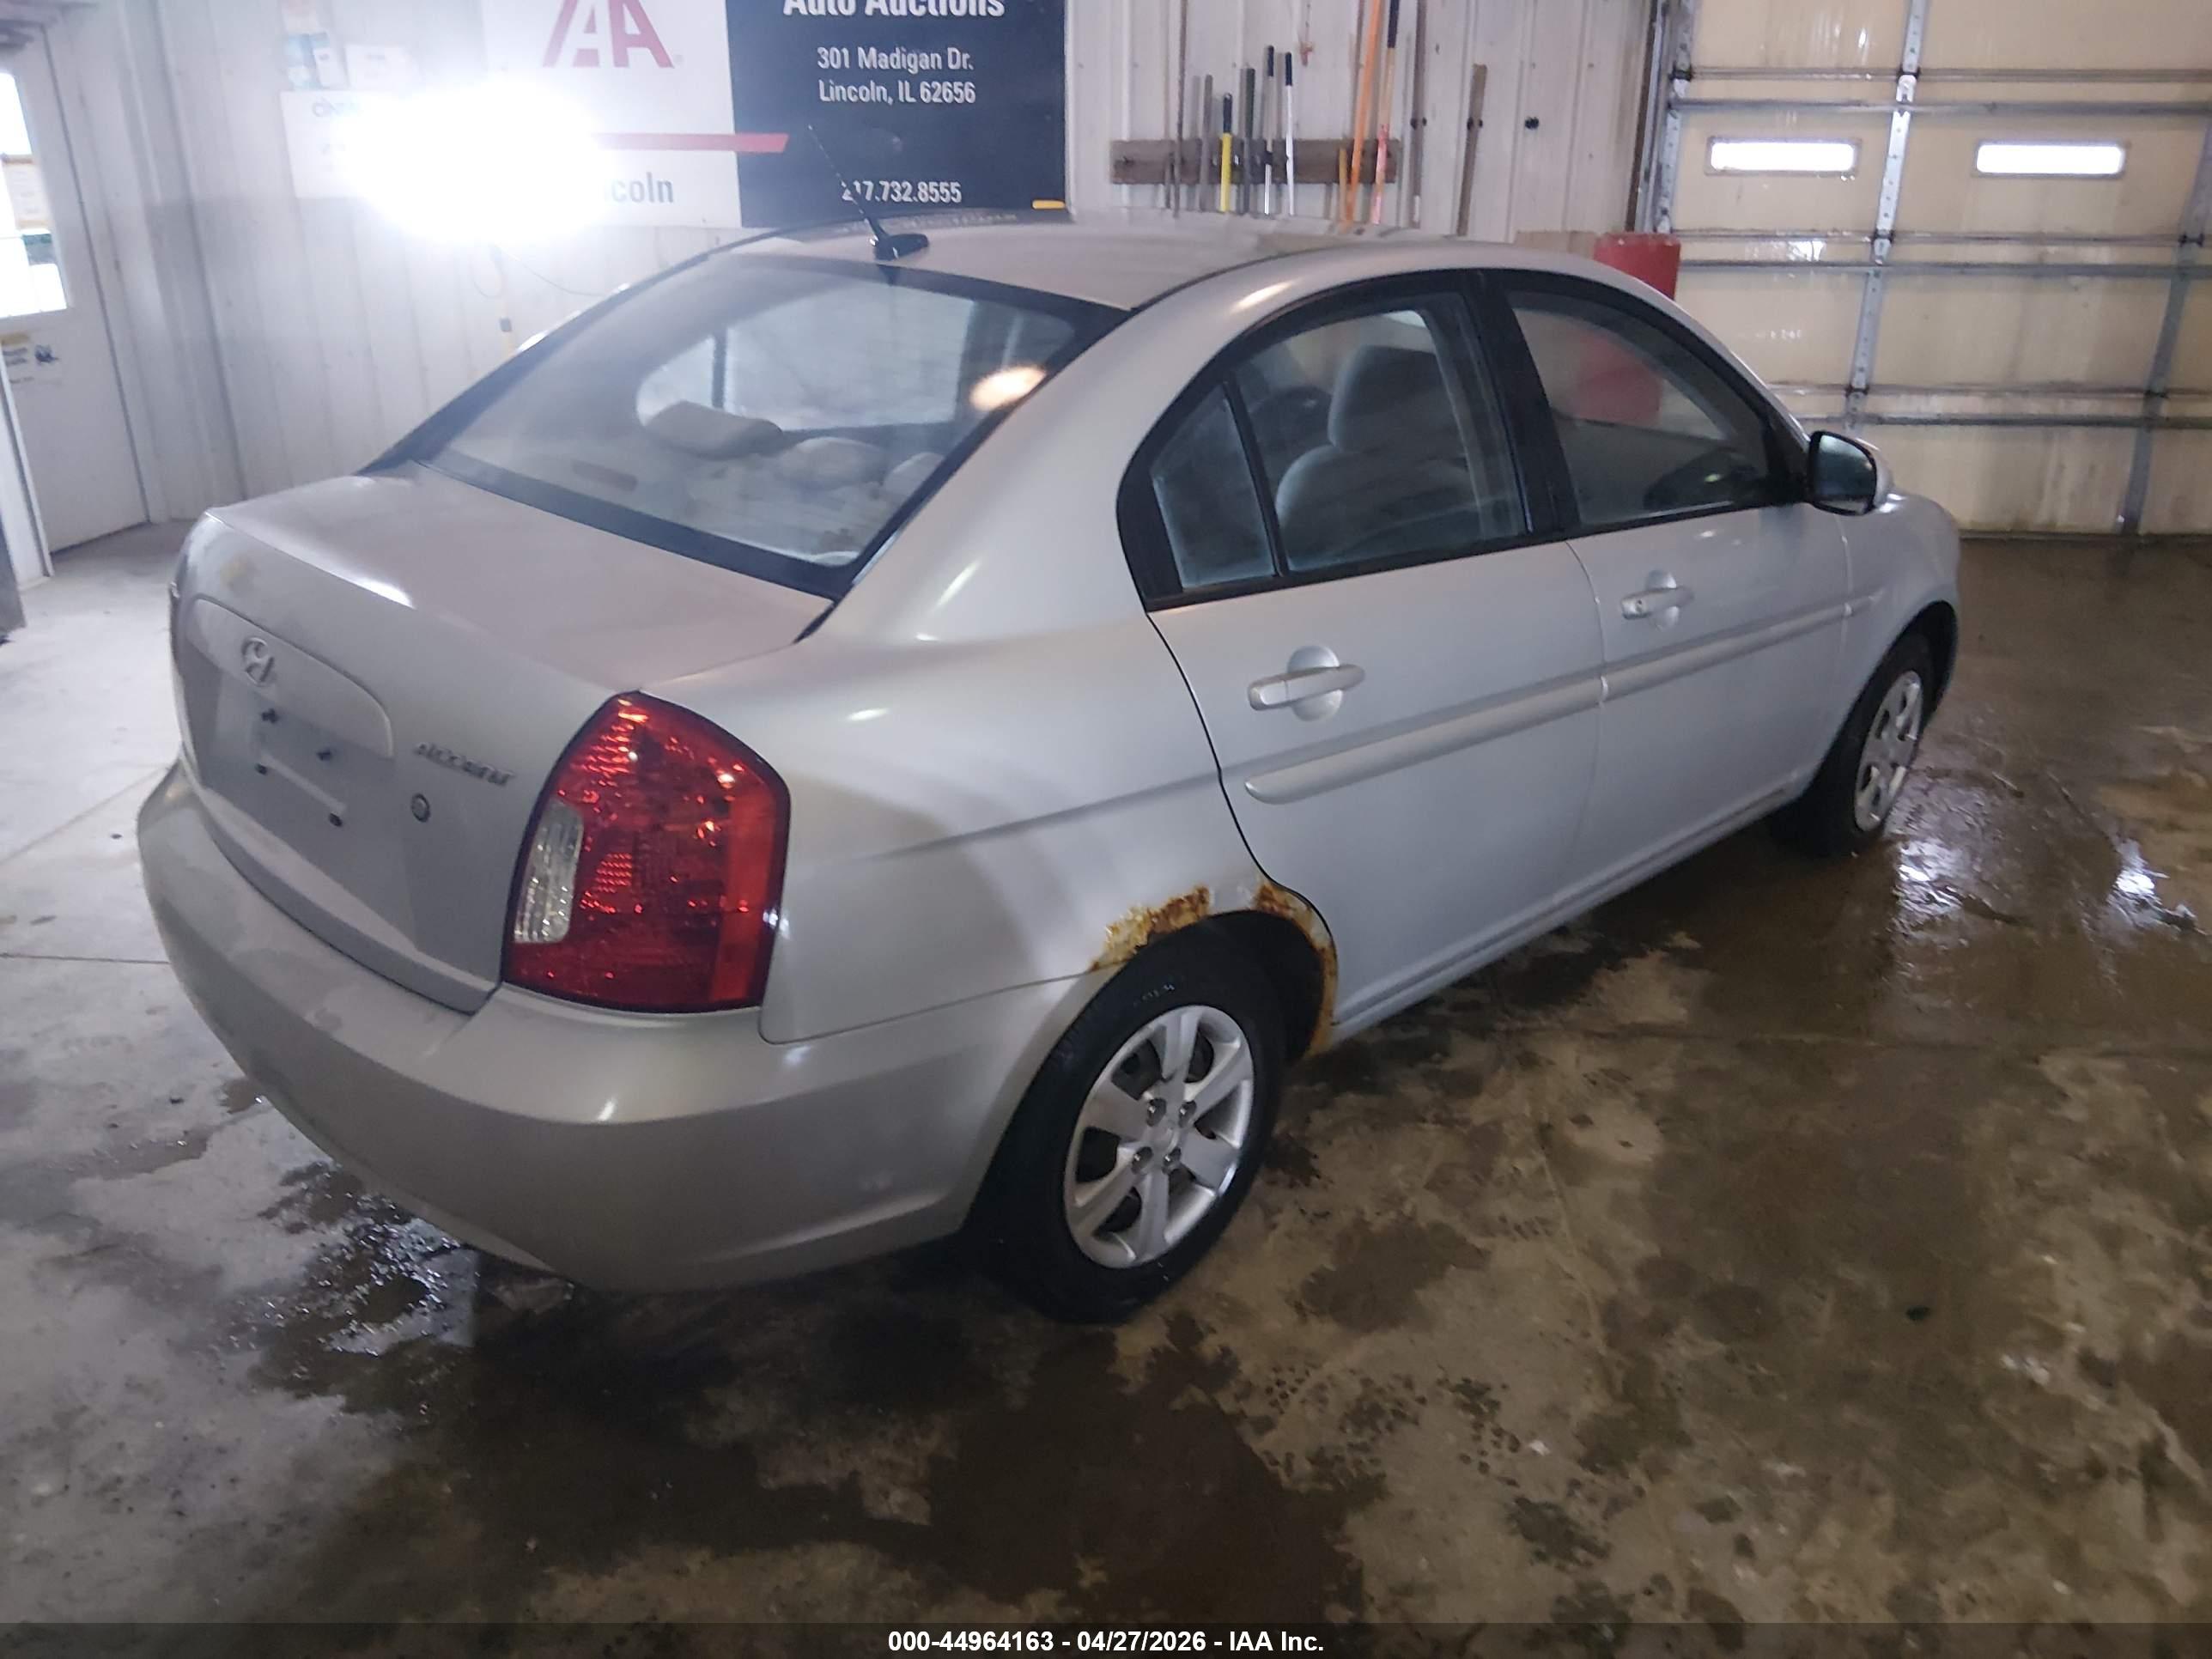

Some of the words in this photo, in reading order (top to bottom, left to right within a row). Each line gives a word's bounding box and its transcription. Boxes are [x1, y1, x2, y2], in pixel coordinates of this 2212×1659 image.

[817, 47, 850, 69] 301
[857, 47, 943, 74] Madigan
[947, 47, 974, 70] Dr.
[818, 79, 893, 105] Lincoln,
[898, 80, 916, 102] IL
[921, 81, 976, 103] 62656
